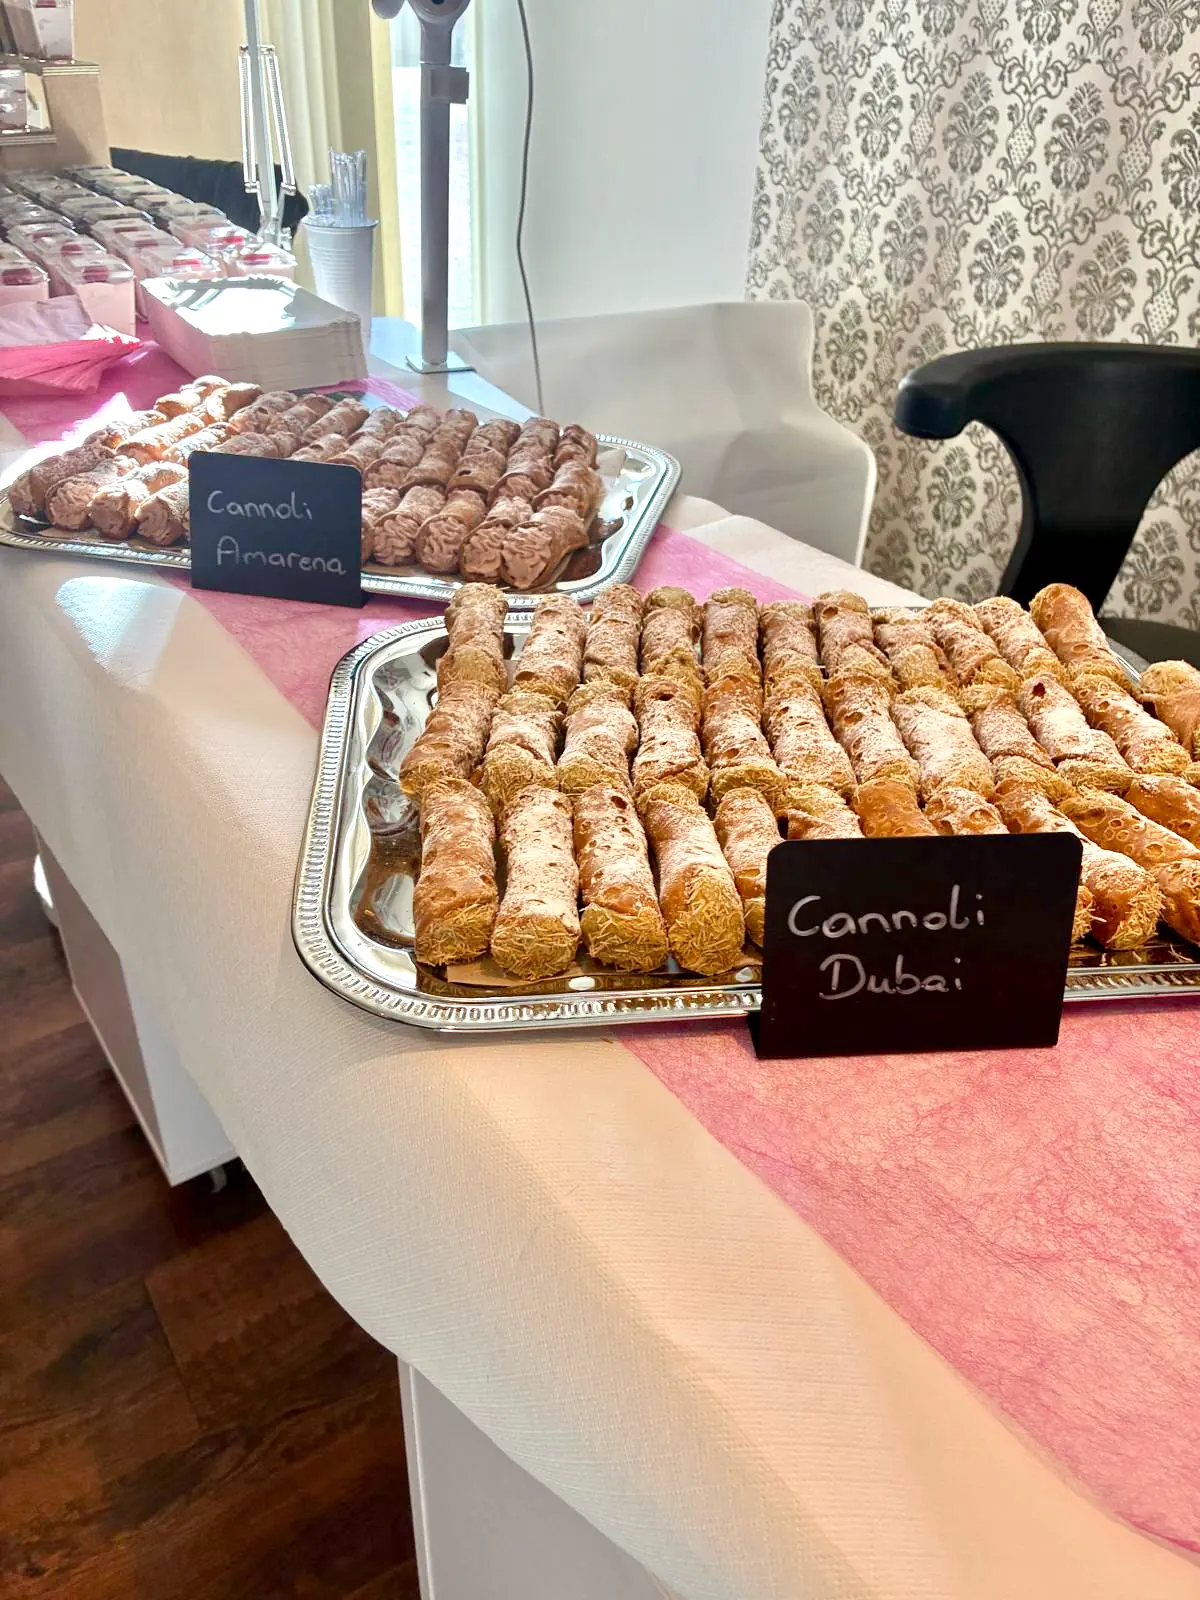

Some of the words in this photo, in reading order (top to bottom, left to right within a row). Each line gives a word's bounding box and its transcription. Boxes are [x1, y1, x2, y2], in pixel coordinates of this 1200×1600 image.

[207, 490, 312, 519] Cannoli
[216, 535, 347, 575] Amarena
[787, 884, 985, 938] Cannoli
[818, 953, 963, 1000] Dubai
